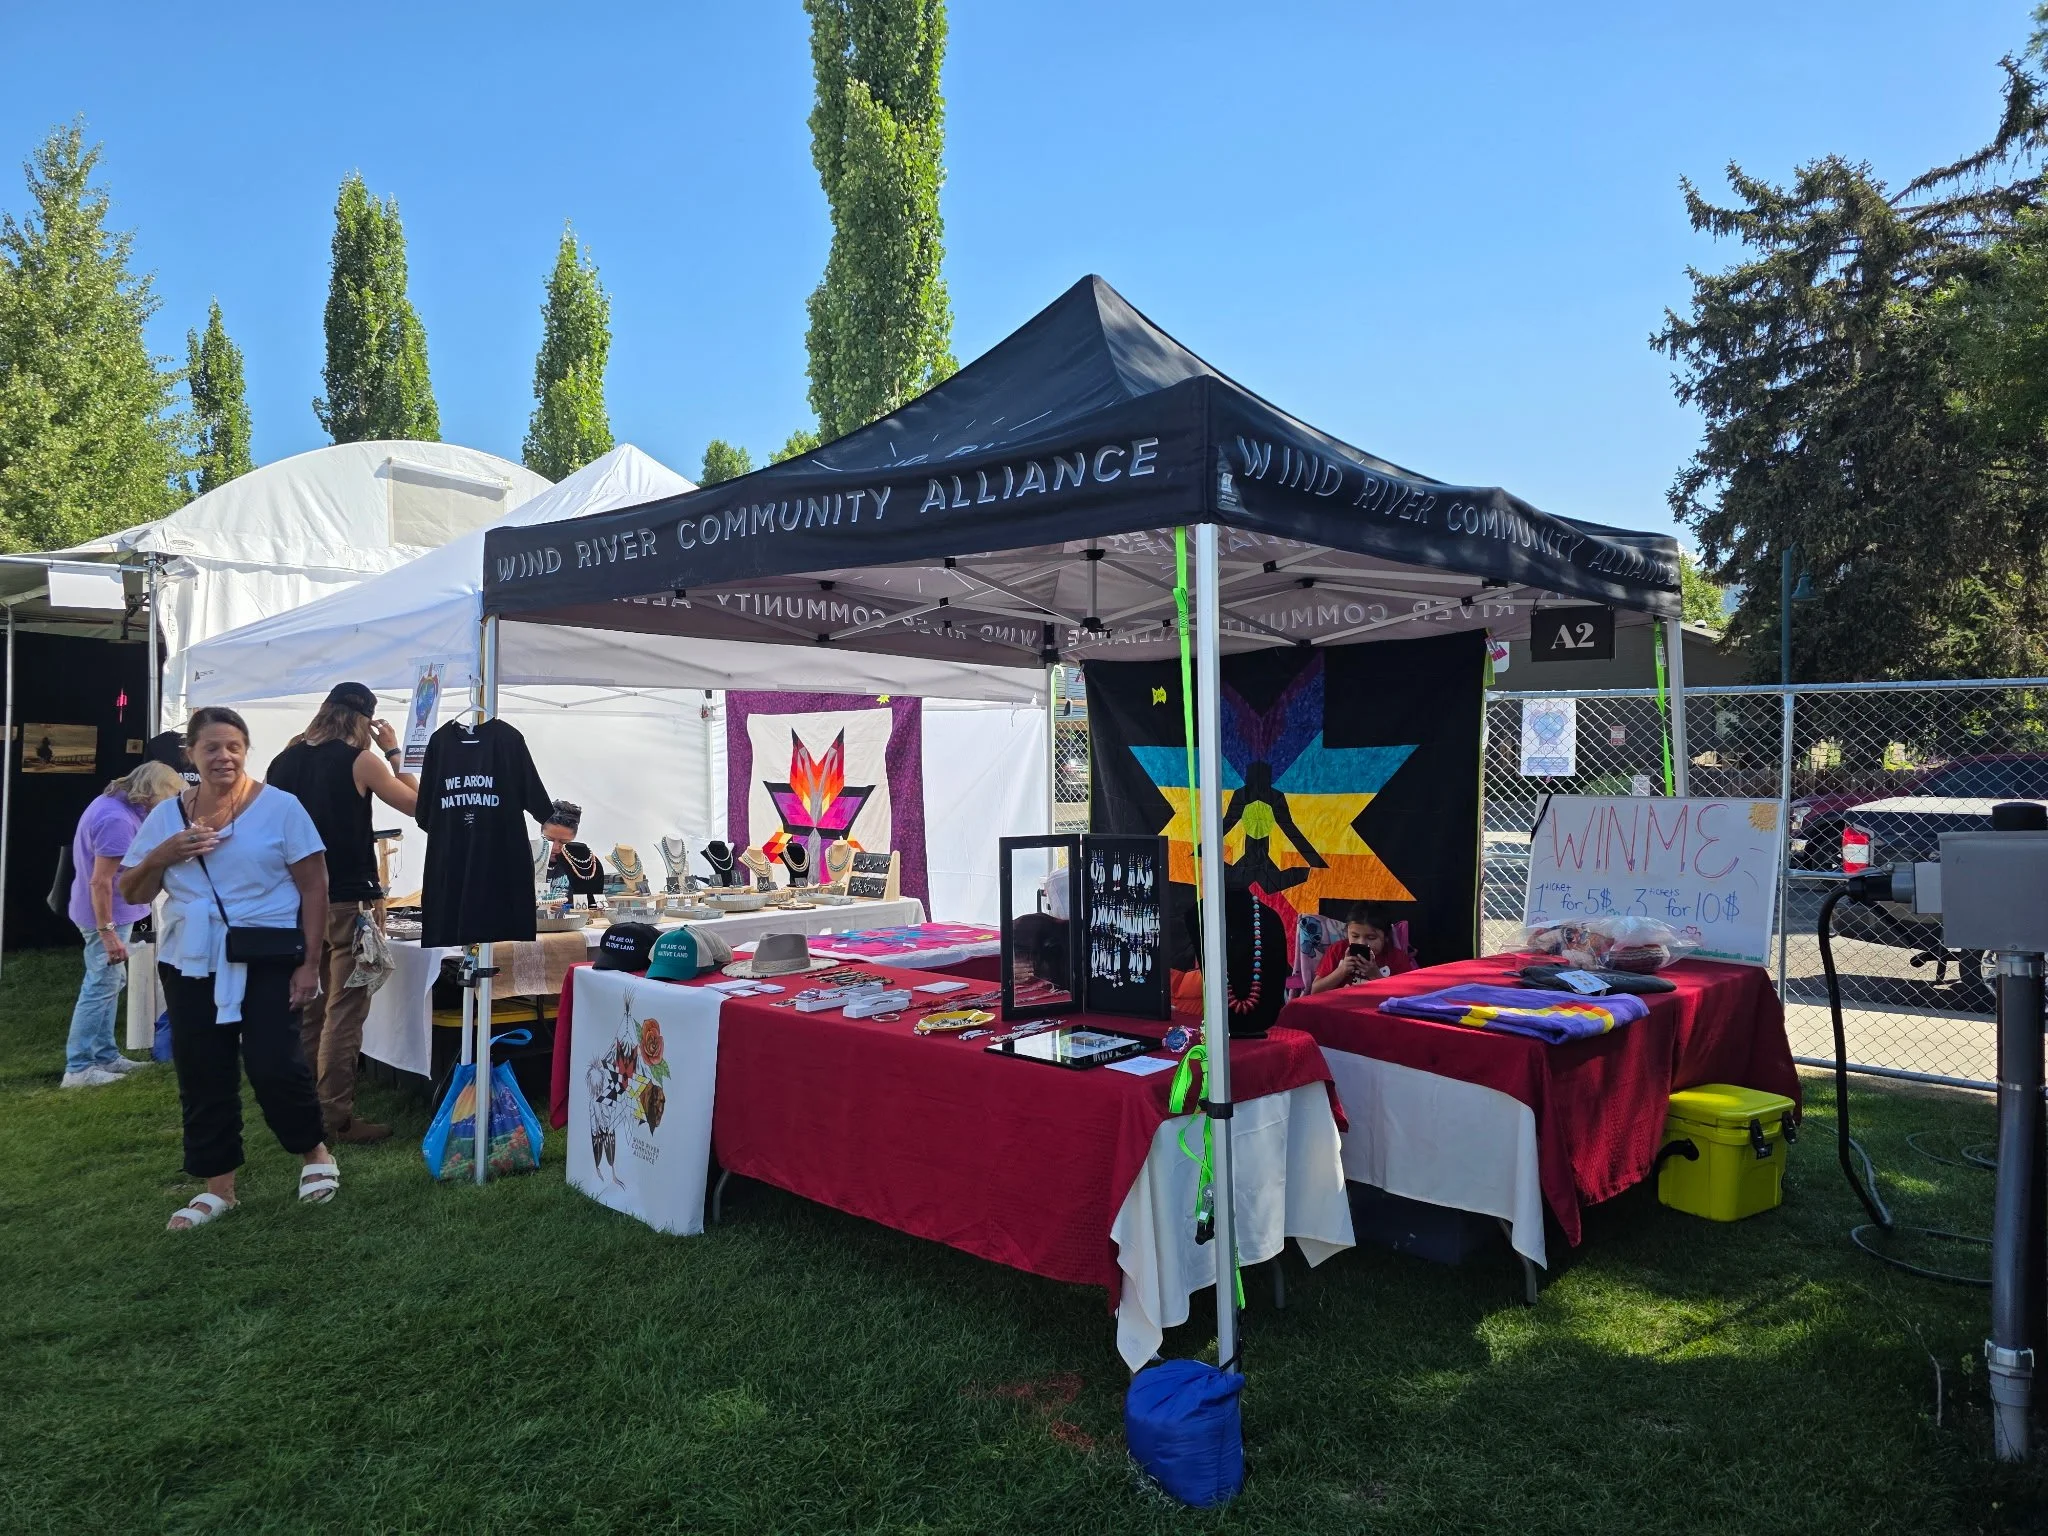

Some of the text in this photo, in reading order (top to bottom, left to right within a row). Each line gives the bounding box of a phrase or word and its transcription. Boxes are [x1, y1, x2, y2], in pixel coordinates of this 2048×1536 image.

[497, 547, 562, 583] WIND
[575, 528, 657, 569] RIVER
[677, 486, 891, 550] COMMUNITY
[919, 438, 1159, 513] ALLIANCE
[1237, 435, 1676, 586] WIND RIVER COMMUNITY ALLIANCE
[1550, 622, 1595, 650] A2
[445, 776, 461, 790] WE
[1561, 893, 1583, 911] for
[1665, 898, 1692, 917] for
